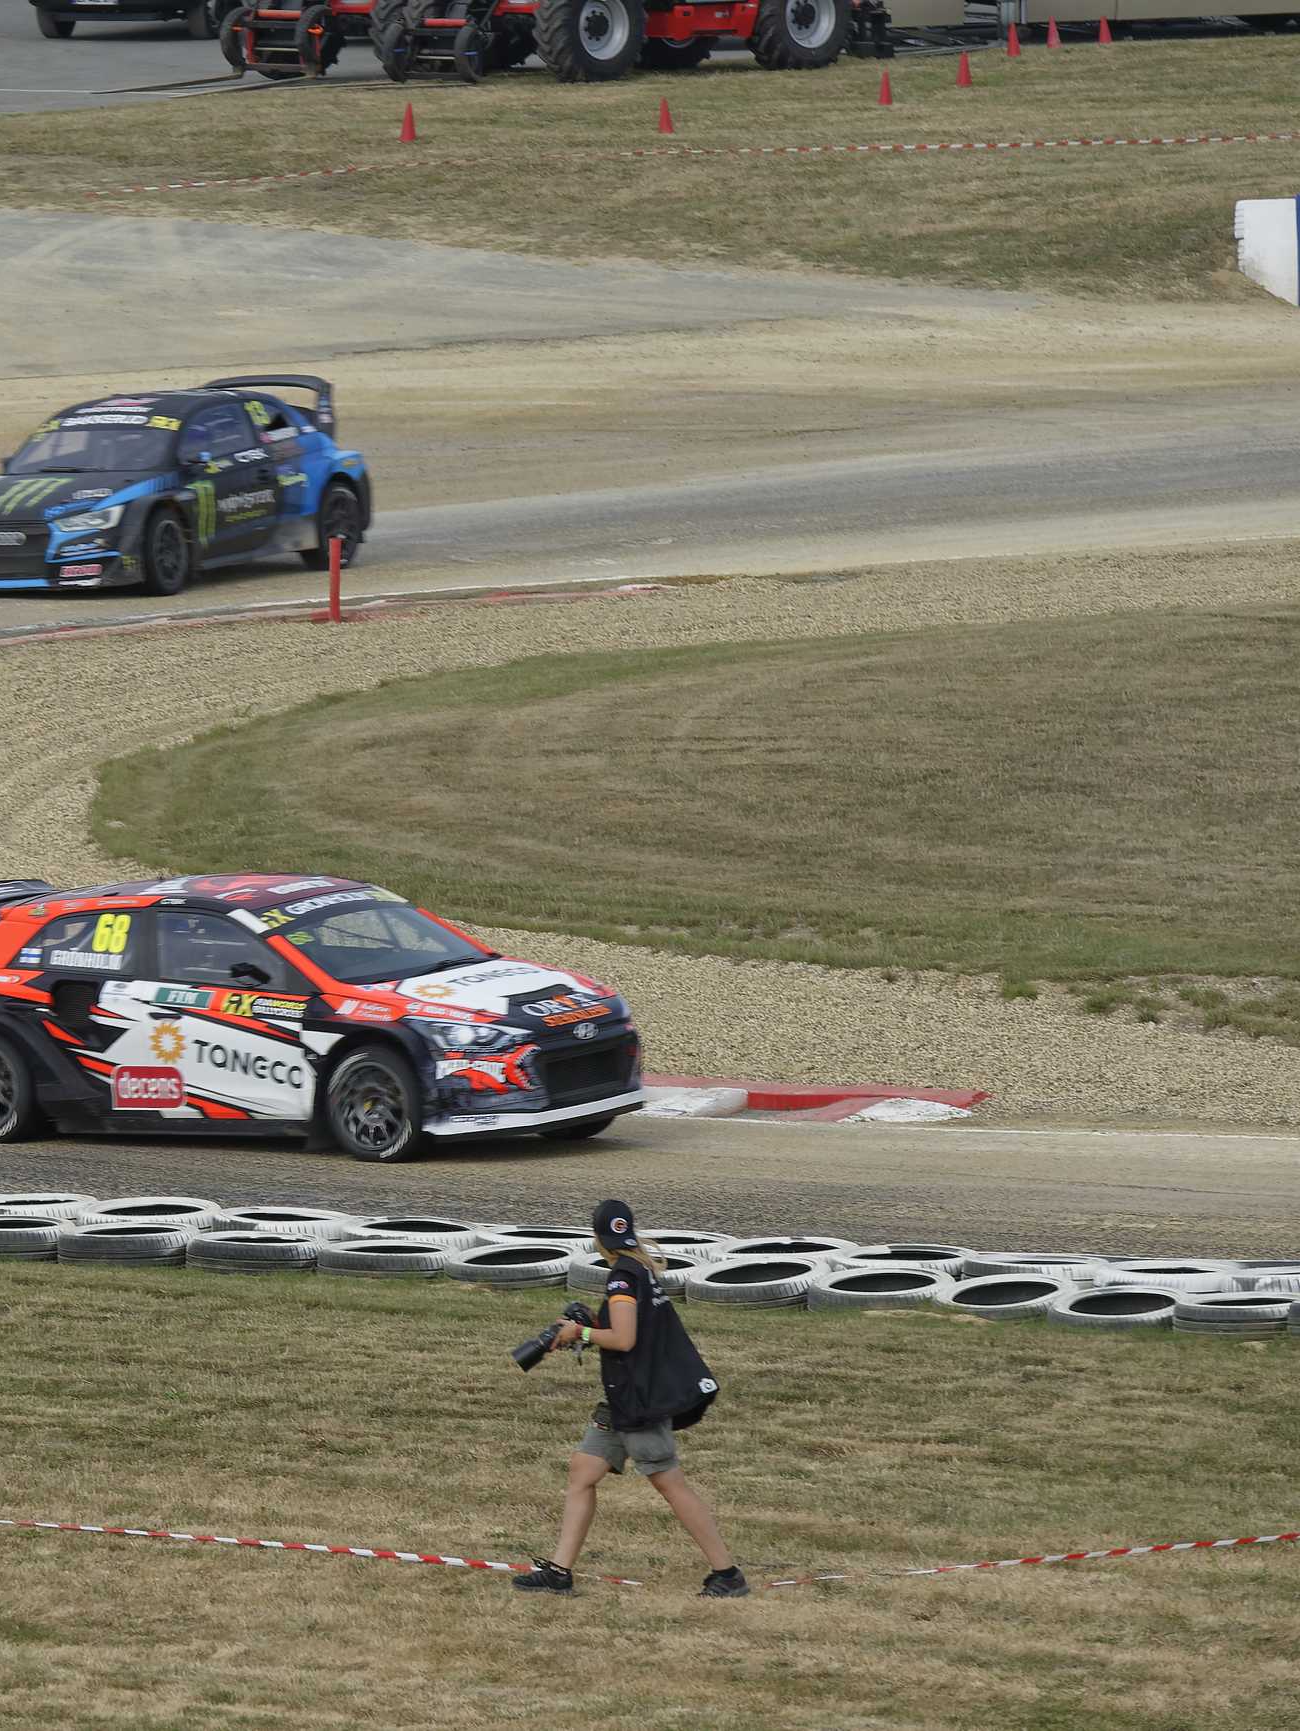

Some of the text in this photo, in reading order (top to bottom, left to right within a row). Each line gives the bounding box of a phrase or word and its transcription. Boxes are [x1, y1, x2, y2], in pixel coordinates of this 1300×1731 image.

[91, 913, 132, 954] 68
[191, 1039, 305, 1090] TONECO
[118, 1071, 180, 1100] decens
